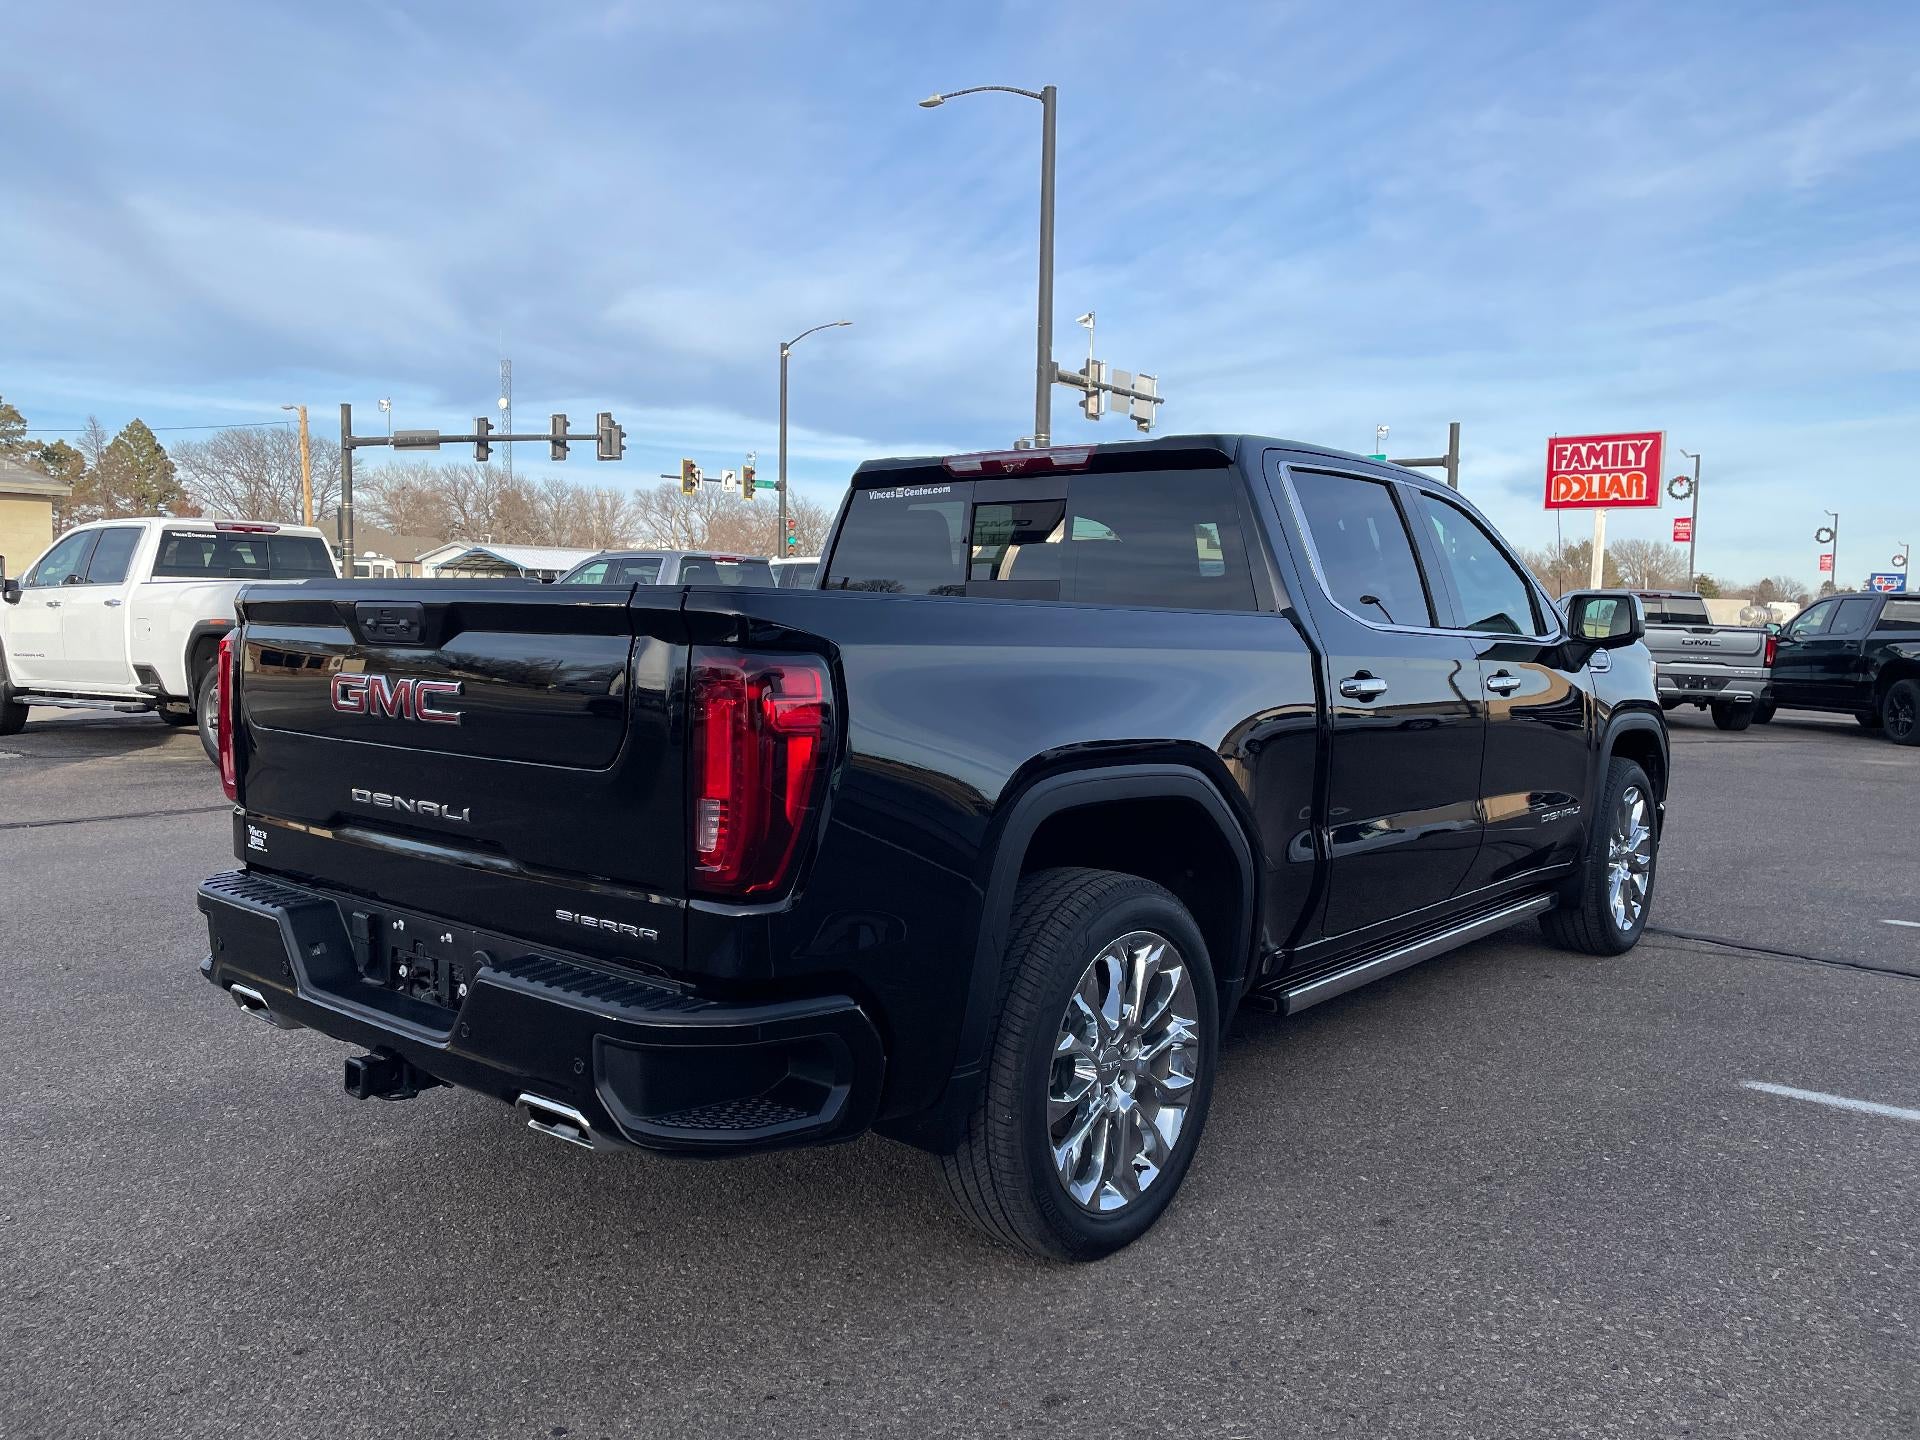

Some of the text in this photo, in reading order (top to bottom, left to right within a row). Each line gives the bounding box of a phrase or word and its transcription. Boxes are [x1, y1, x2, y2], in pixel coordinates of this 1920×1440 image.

[1553, 440, 1654, 471] FAMILY
[868, 490, 895, 500] Vinces
[904, 486, 951, 497] Center.com
[1551, 471, 1648, 502] DOLLAR
[1681, 637, 1721, 647] GMC
[331, 672, 467, 726] GMC
[351, 788, 471, 823] DENALI
[1541, 806, 1580, 822] DENALI
[555, 909, 660, 941] SIERRA
